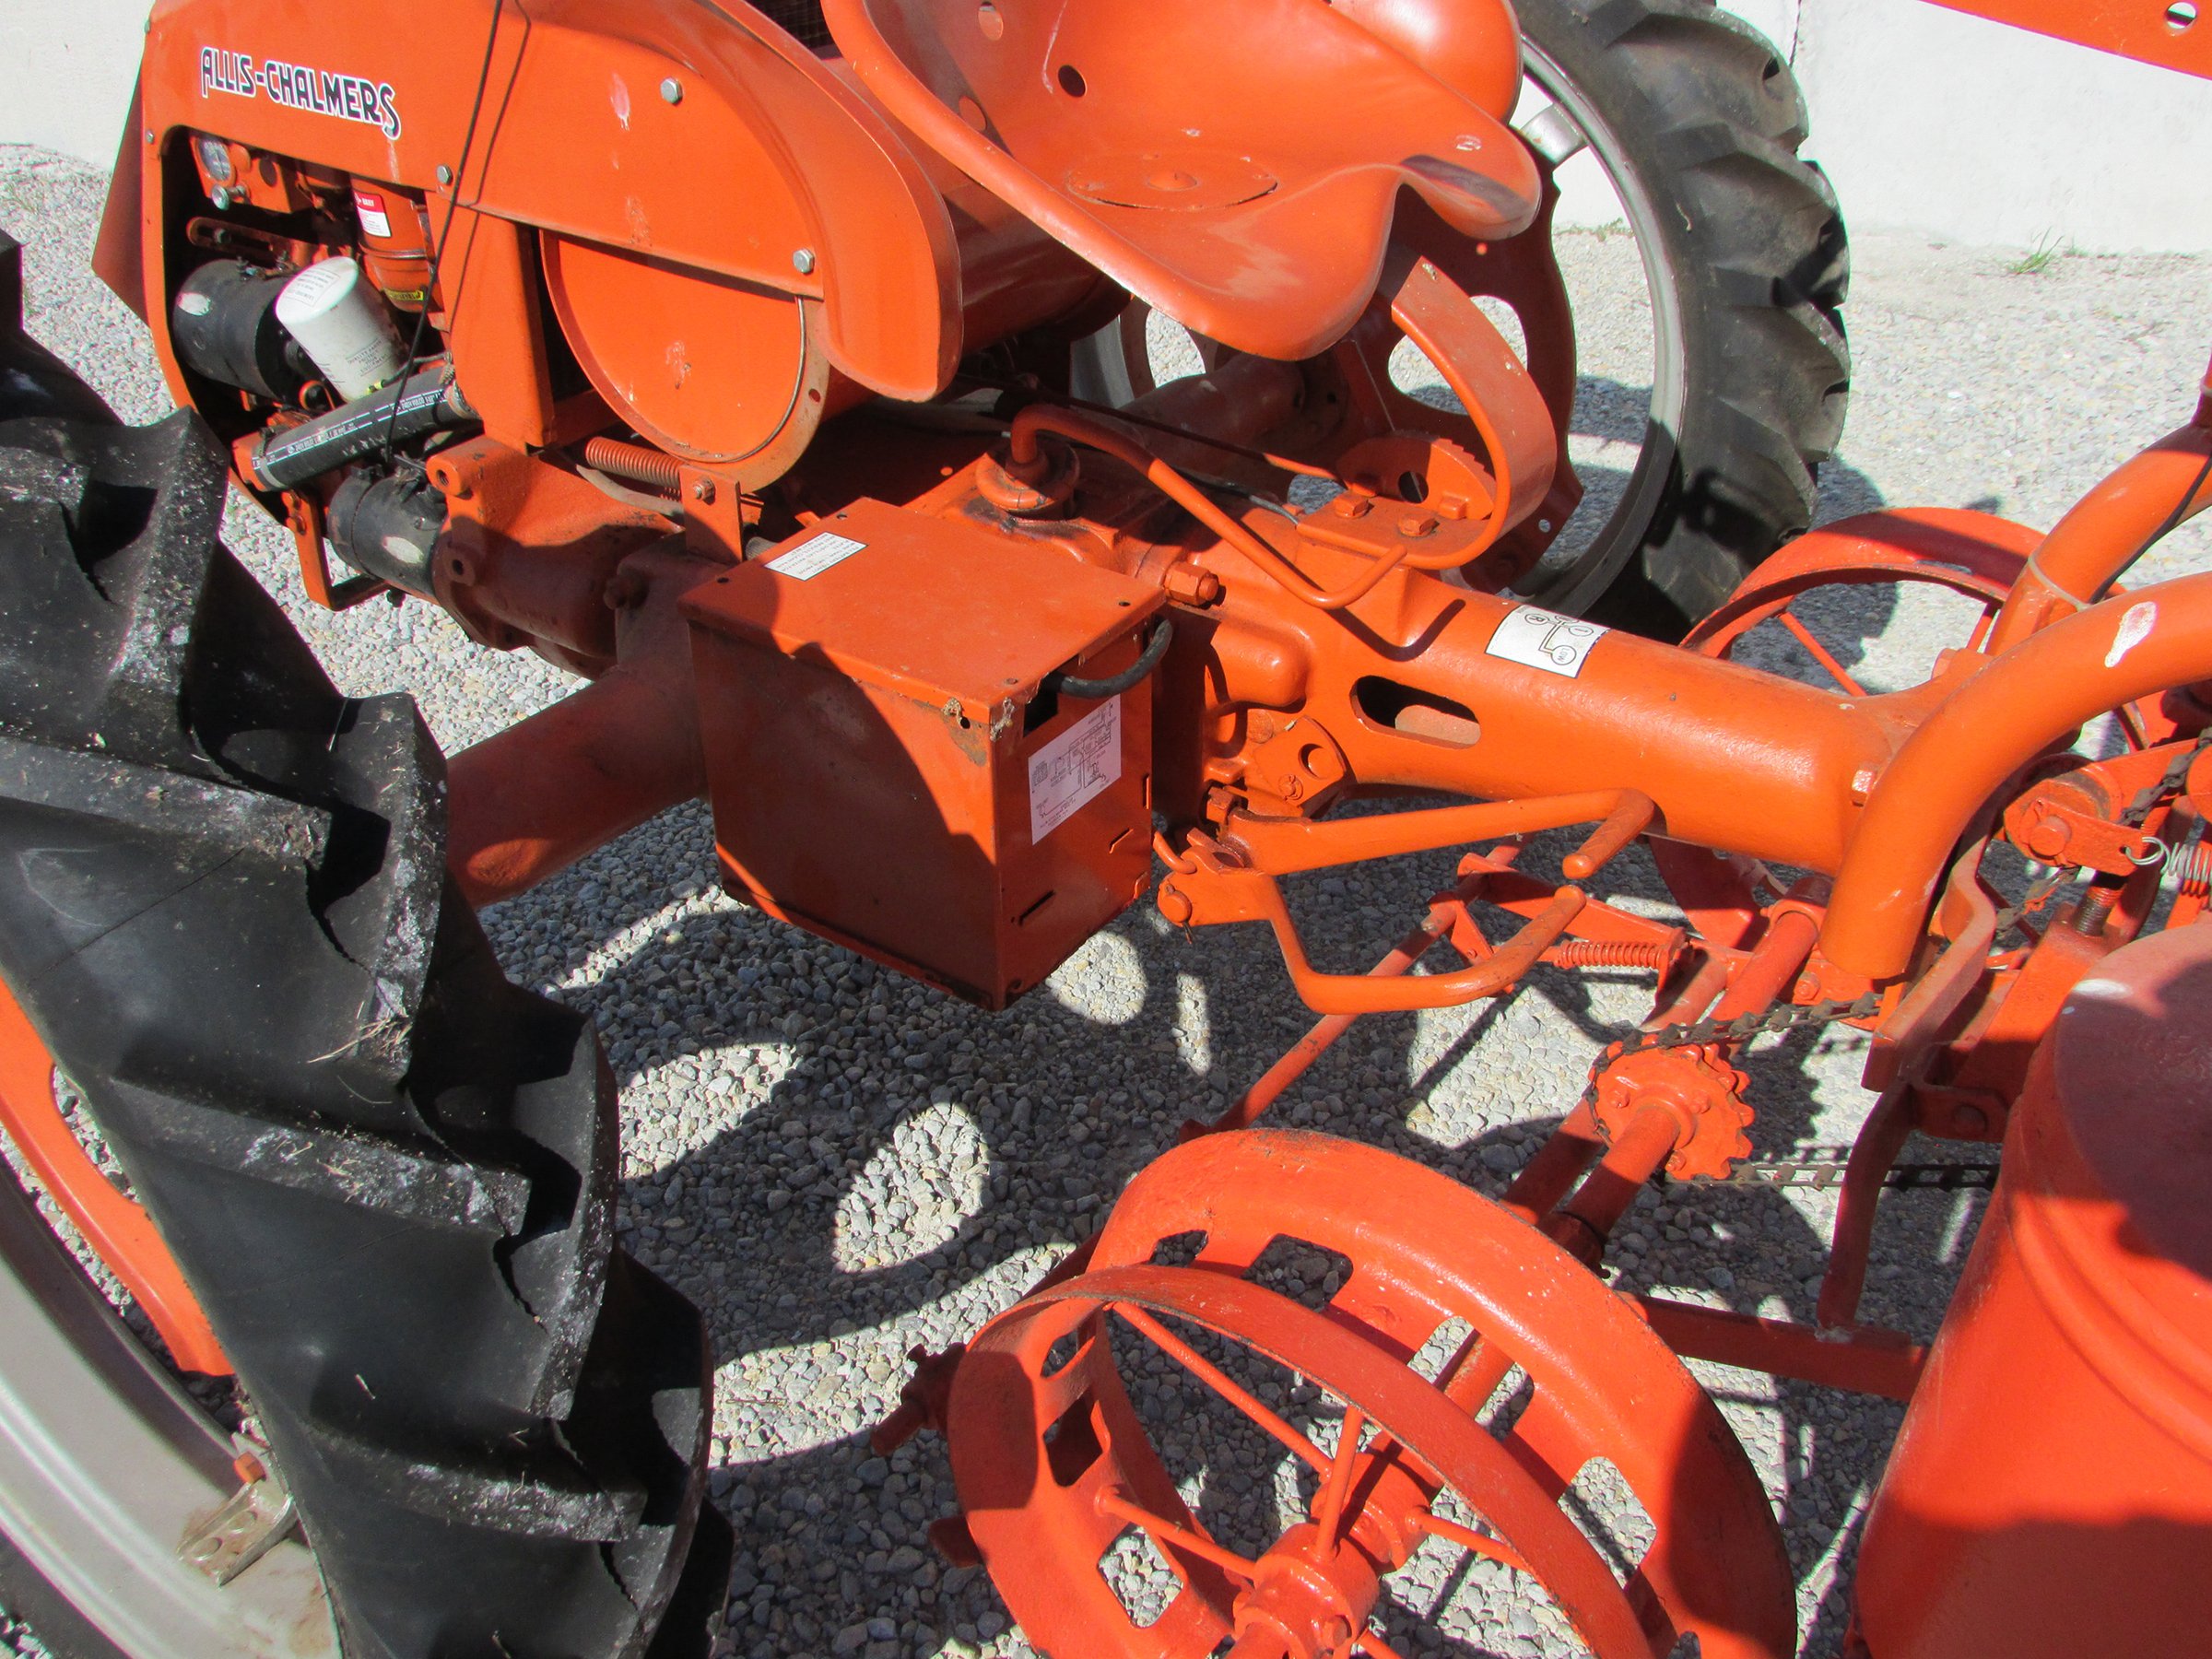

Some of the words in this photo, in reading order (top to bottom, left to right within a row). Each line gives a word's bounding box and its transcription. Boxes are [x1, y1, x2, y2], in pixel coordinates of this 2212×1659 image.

[201, 46, 401, 140] ALLIS-CHALMERS
[1528, 615, 1546, 623] R
[1557, 648, 1570, 662] LOW
